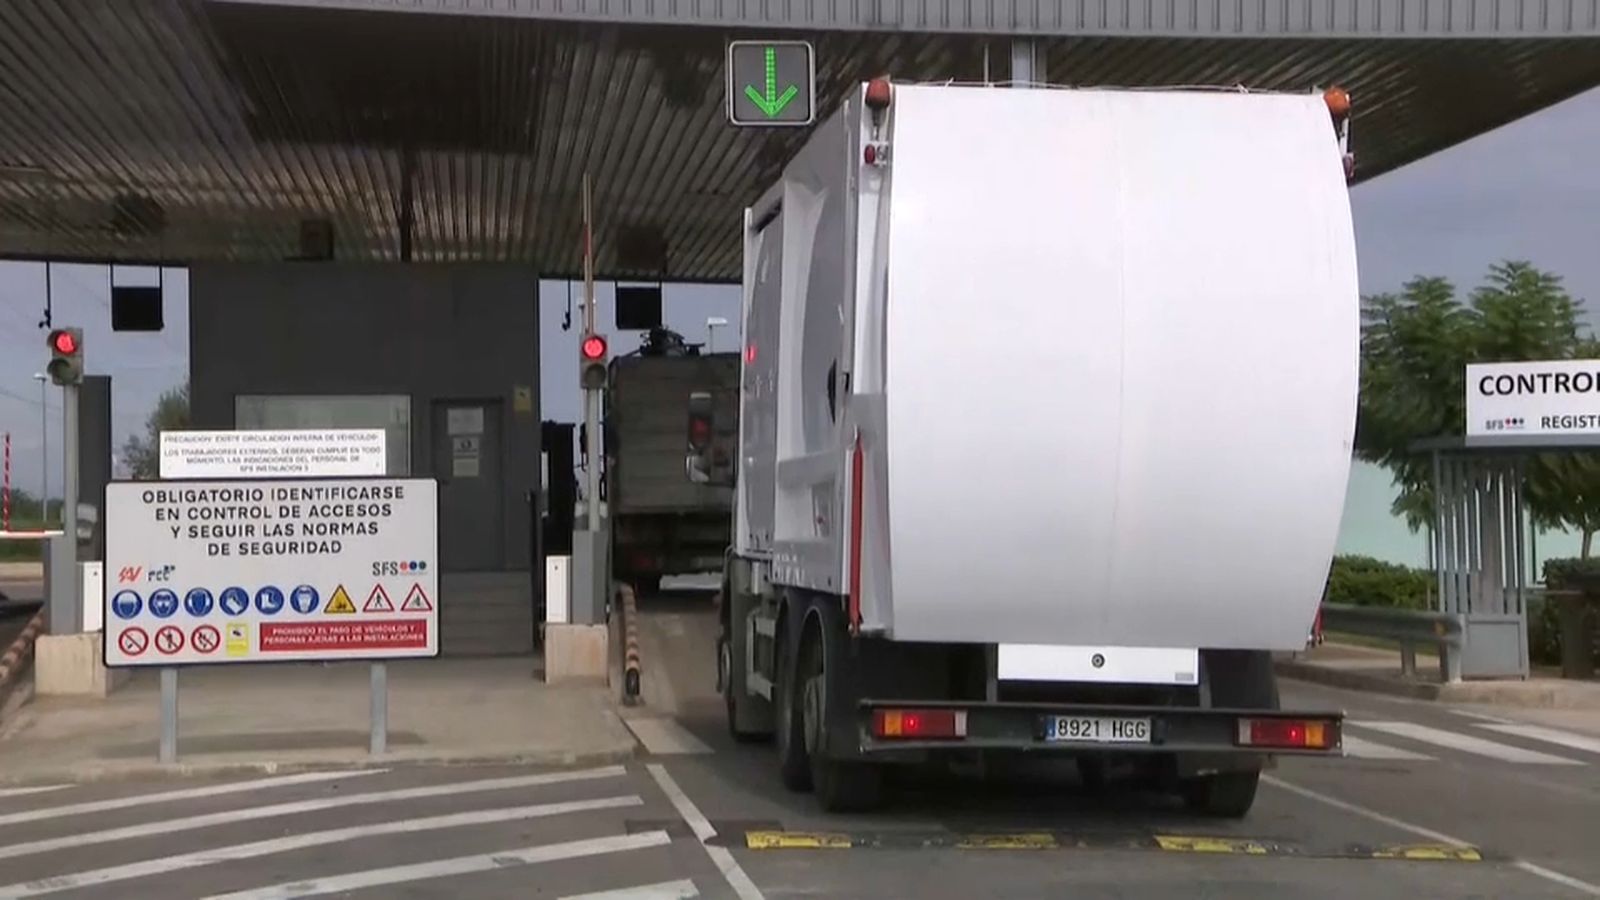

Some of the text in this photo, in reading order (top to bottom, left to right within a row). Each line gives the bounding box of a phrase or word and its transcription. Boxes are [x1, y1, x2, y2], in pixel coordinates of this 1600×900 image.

[1541, 414, 1600, 429] REGIST
[325, 433, 335, 441] DE
[164, 448, 179, 457] LOS
[181, 448, 237, 456] TRABAJADORES
[350, 446, 360, 454] EN
[361, 446, 381, 454] TODO
[243, 456, 294, 464] INDICACIONES
[311, 455, 348, 463] PERSONAL
[142, 486, 404, 504] OBLIGATORIO IDENTIFICARSE
[155, 503, 392, 520] EN CONTROL DE ACCESOS
[171, 521, 379, 539] Y SEGUIR LAS NORMAS
[208, 540, 342, 556] DE SEGURIDAD
[372, 560, 399, 577] SFS
[318, 626, 328, 634] EL
[351, 625, 362, 633] DE
[1057, 719, 1100, 737] 8921
[1112, 720, 1147, 739] HGG
